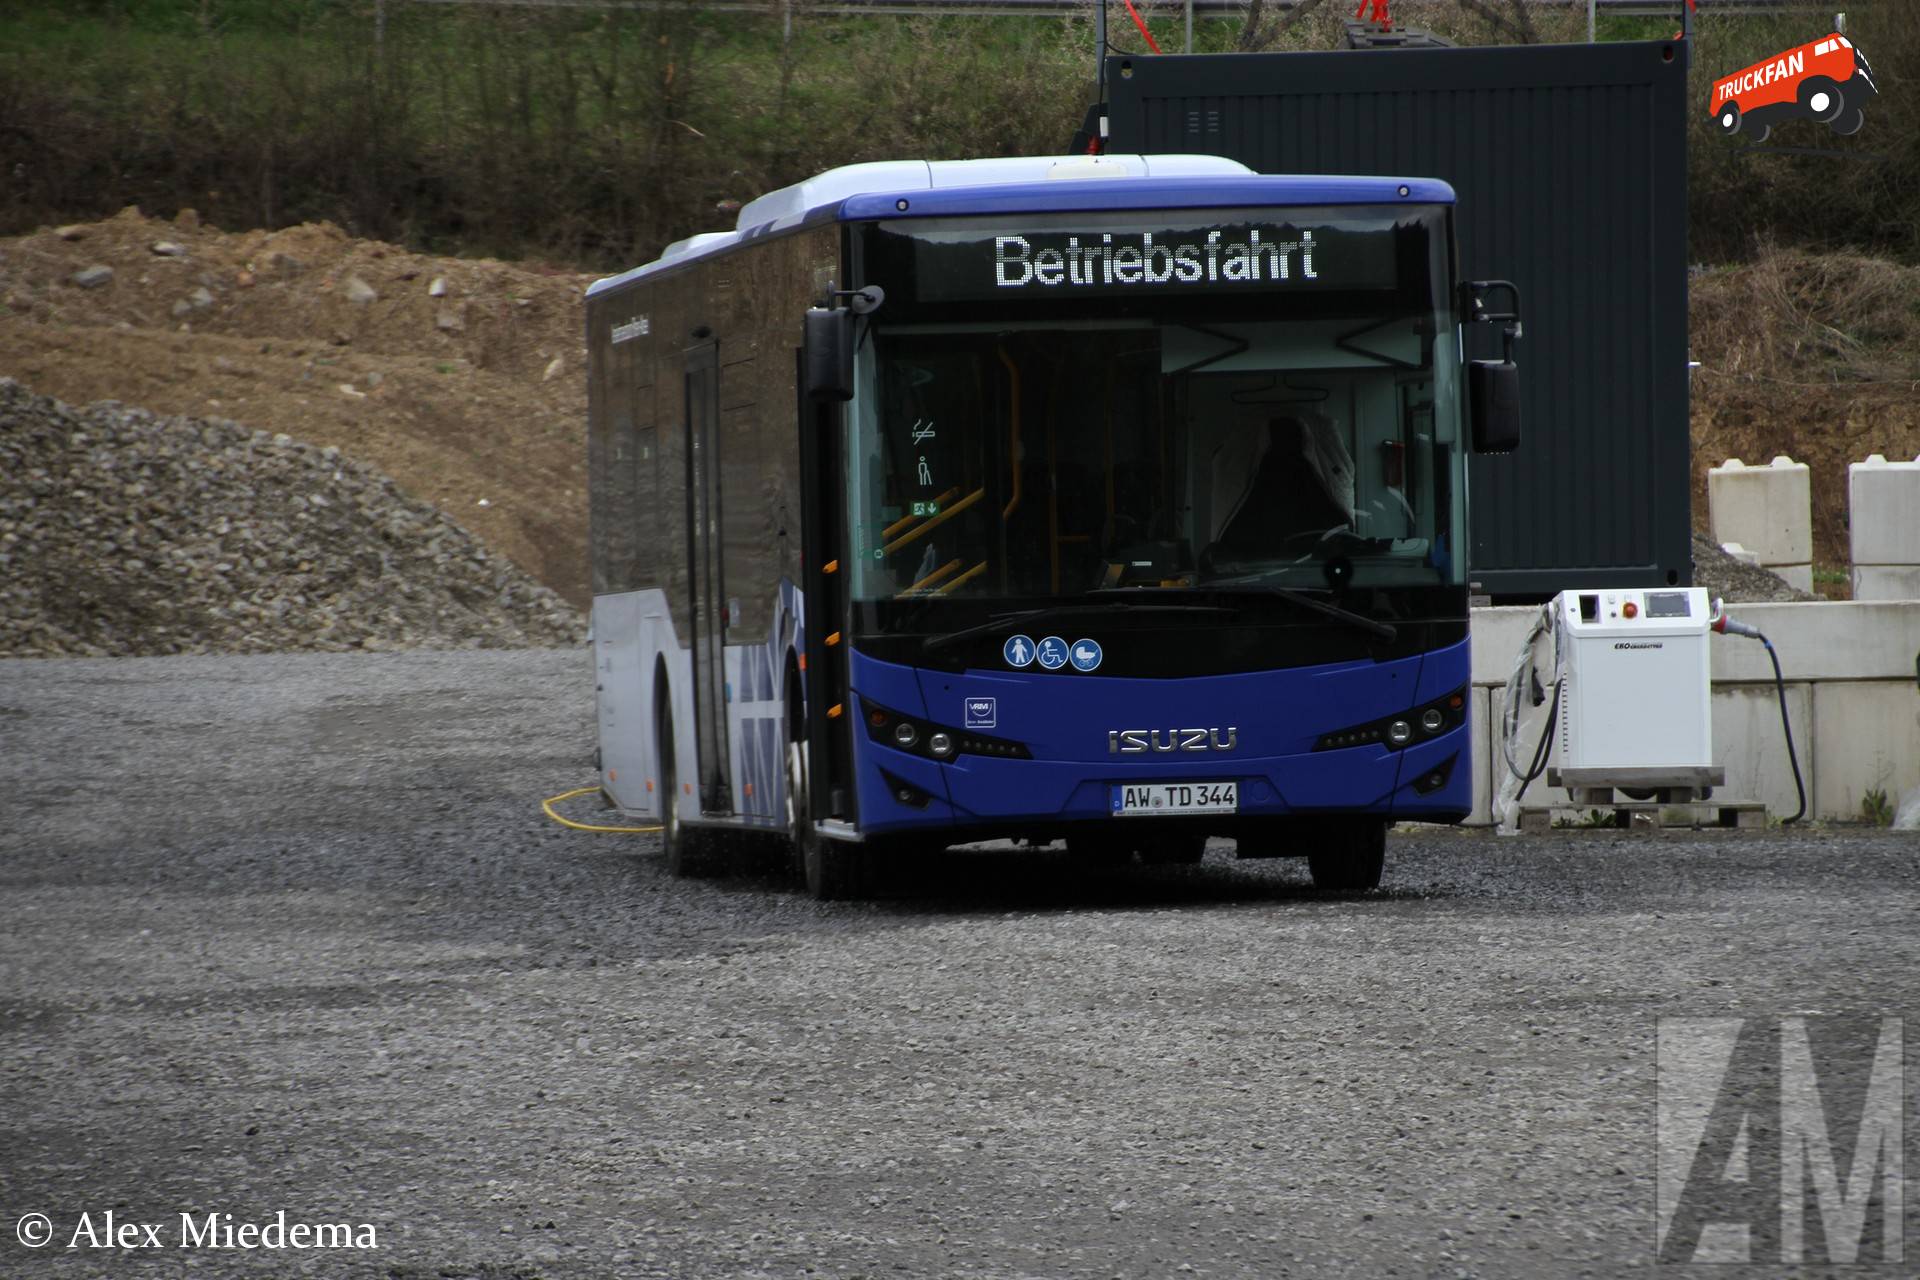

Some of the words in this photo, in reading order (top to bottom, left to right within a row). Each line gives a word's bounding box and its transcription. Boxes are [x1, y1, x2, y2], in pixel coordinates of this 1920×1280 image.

[995, 229, 1318, 287] Betriebsfahrt
[1108, 726, 1238, 754] ISUZU
[1124, 786, 1151, 809] AW
[1165, 785, 1192, 807] TD
[1196, 784, 1235, 807] 344
